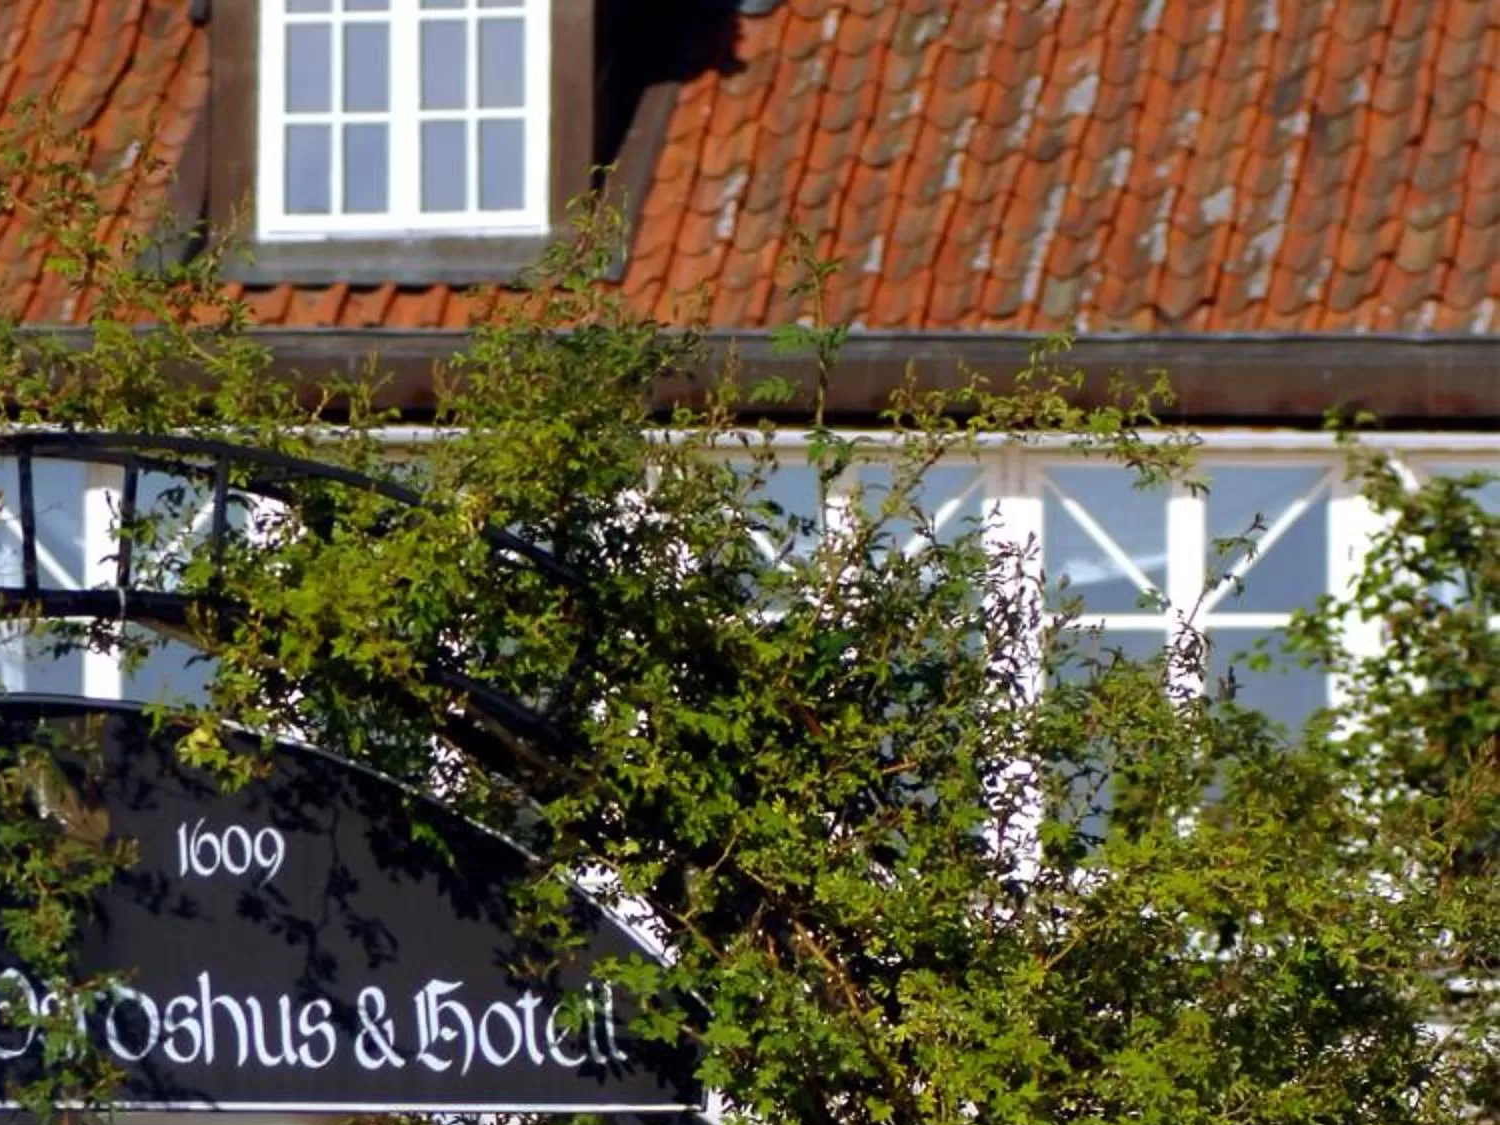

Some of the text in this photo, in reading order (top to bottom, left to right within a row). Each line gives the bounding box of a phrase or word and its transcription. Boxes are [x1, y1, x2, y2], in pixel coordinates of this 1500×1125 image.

[177, 817, 286, 886] 1609
[355, 985, 406, 1070] &
[414, 979, 628, 1077] Hotell
